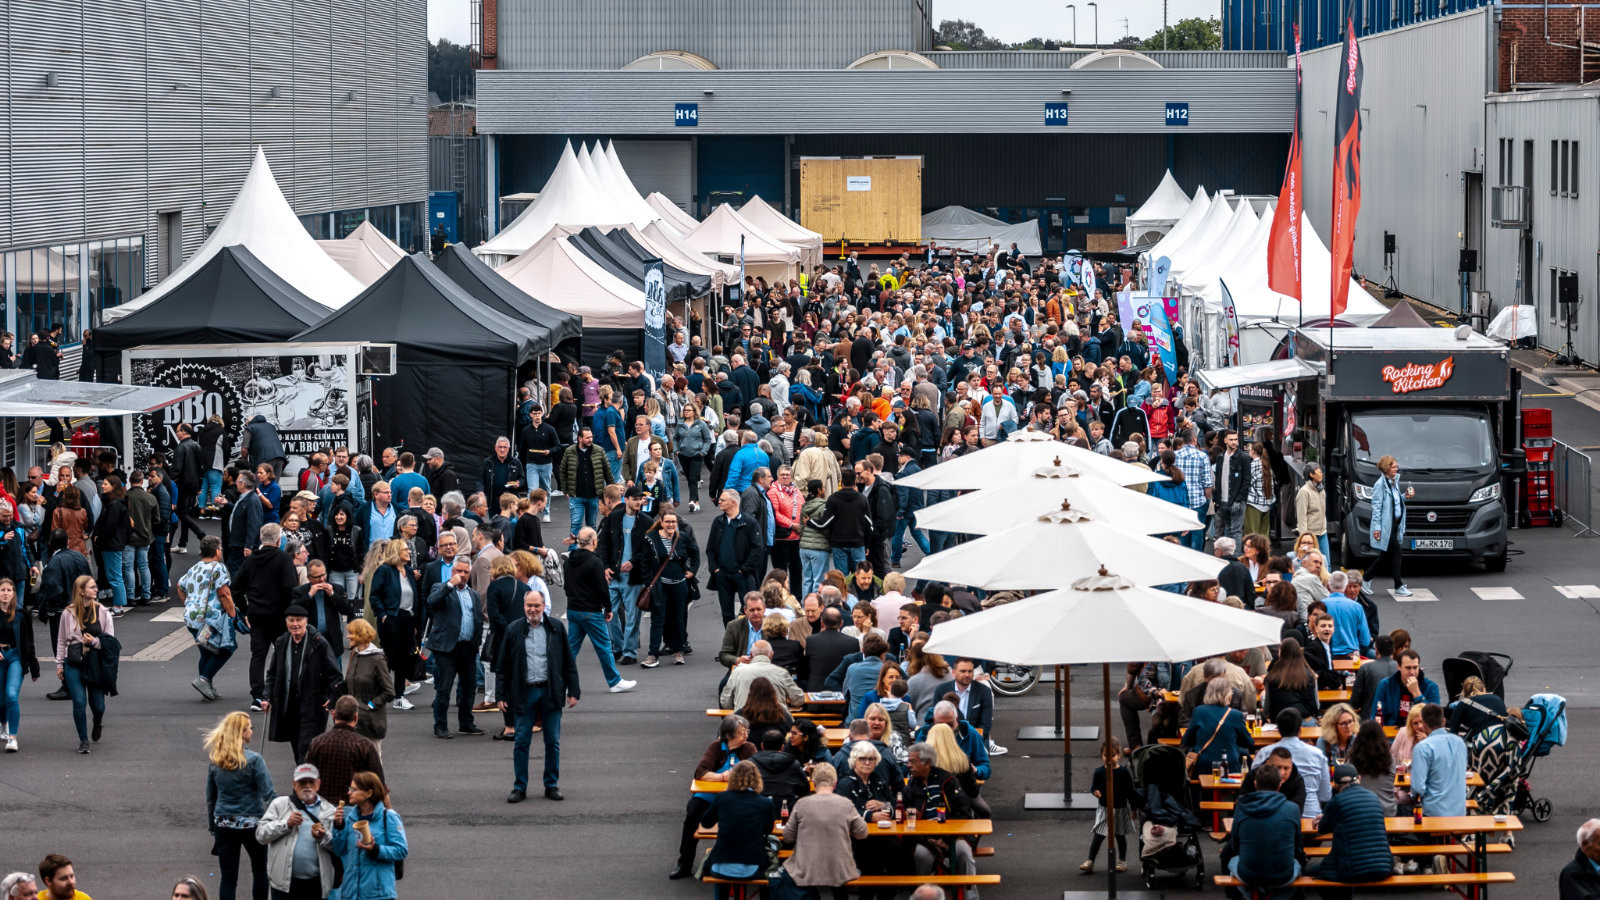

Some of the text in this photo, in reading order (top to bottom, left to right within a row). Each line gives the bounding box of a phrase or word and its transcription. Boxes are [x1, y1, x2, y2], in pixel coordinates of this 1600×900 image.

[675, 109, 697, 120] H14
[1045, 108, 1067, 119] H13
[1166, 108, 1188, 119] H12
[1383, 363, 1435, 381] Rocking
[1393, 375, 1443, 392] Kitchen
